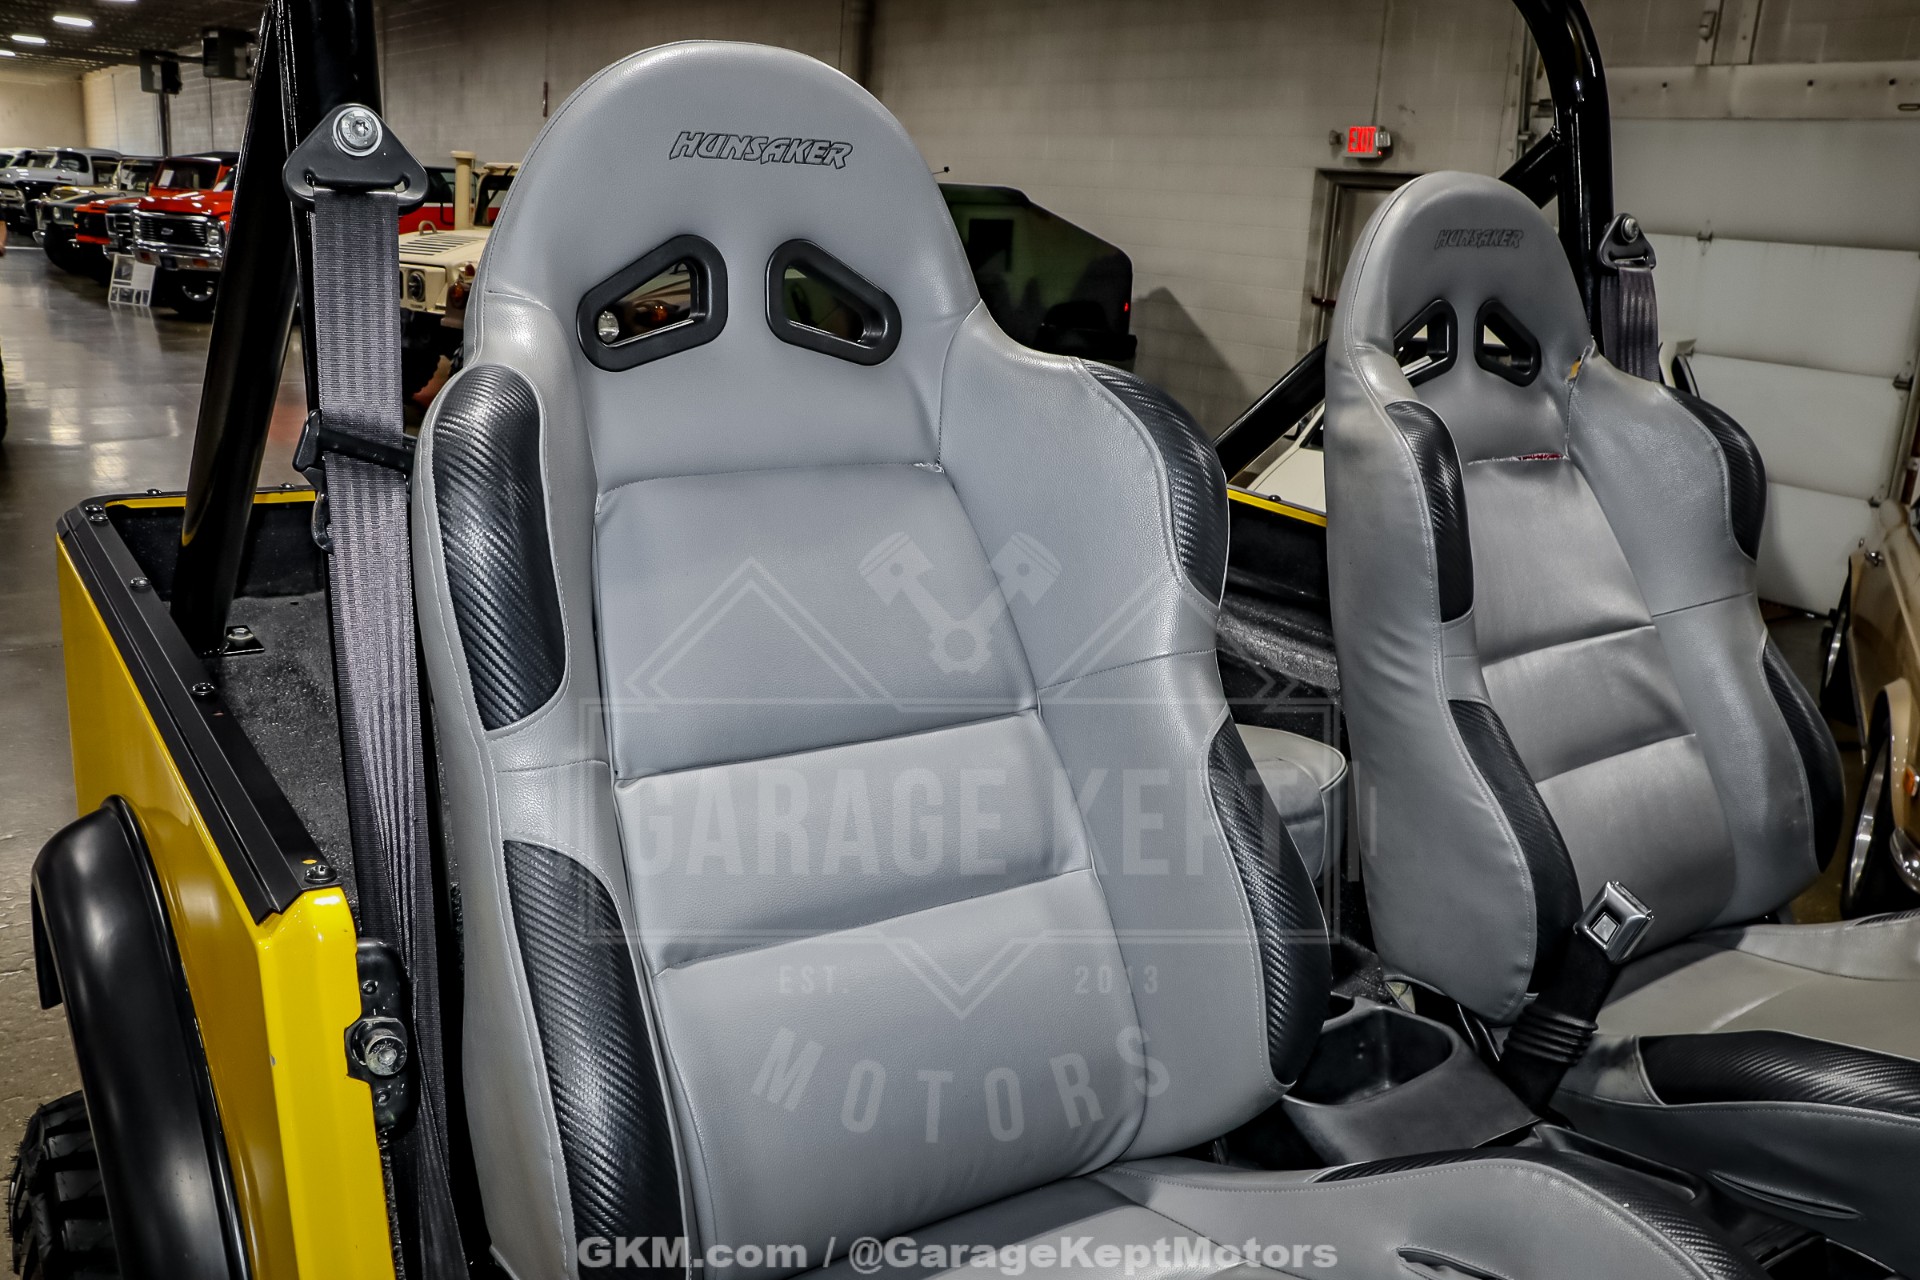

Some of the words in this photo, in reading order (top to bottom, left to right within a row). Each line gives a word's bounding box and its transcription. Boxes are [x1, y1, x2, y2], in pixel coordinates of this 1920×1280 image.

[669, 131, 853, 169] HUNSAKER
[1347, 126, 1377, 153] EXIT
[1434, 229, 1524, 249] HUNSAKER
